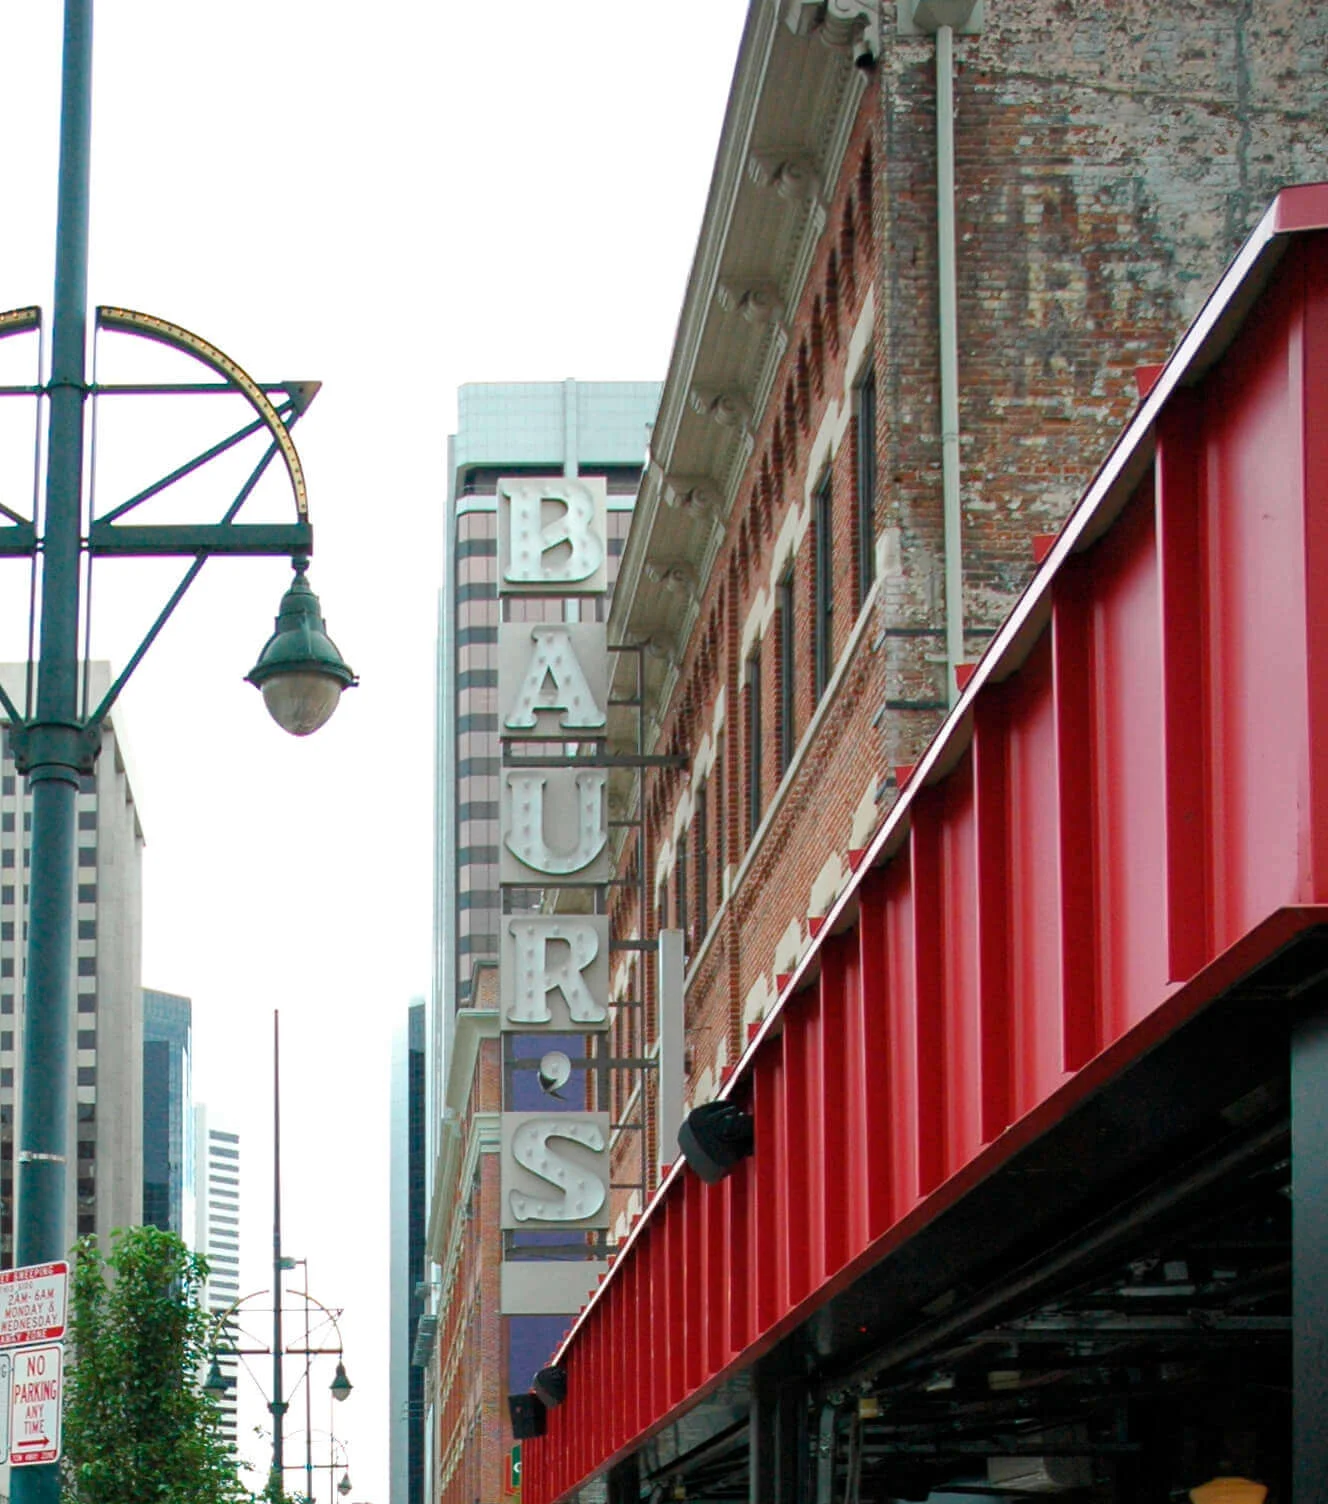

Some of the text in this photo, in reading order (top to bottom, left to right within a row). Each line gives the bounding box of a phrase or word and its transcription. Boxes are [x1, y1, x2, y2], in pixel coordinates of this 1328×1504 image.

[502, 481, 607, 1223] BAUR'S
[5, 1303, 43, 1318] MONDAY
[1, 1313, 58, 1331] WEDNESDAY
[27, 1355, 45, 1377] NO
[14, 1380, 57, 1404] PARKING
[25, 1404, 44, 1419] ANY
[24, 1420, 45, 1435] TIME
